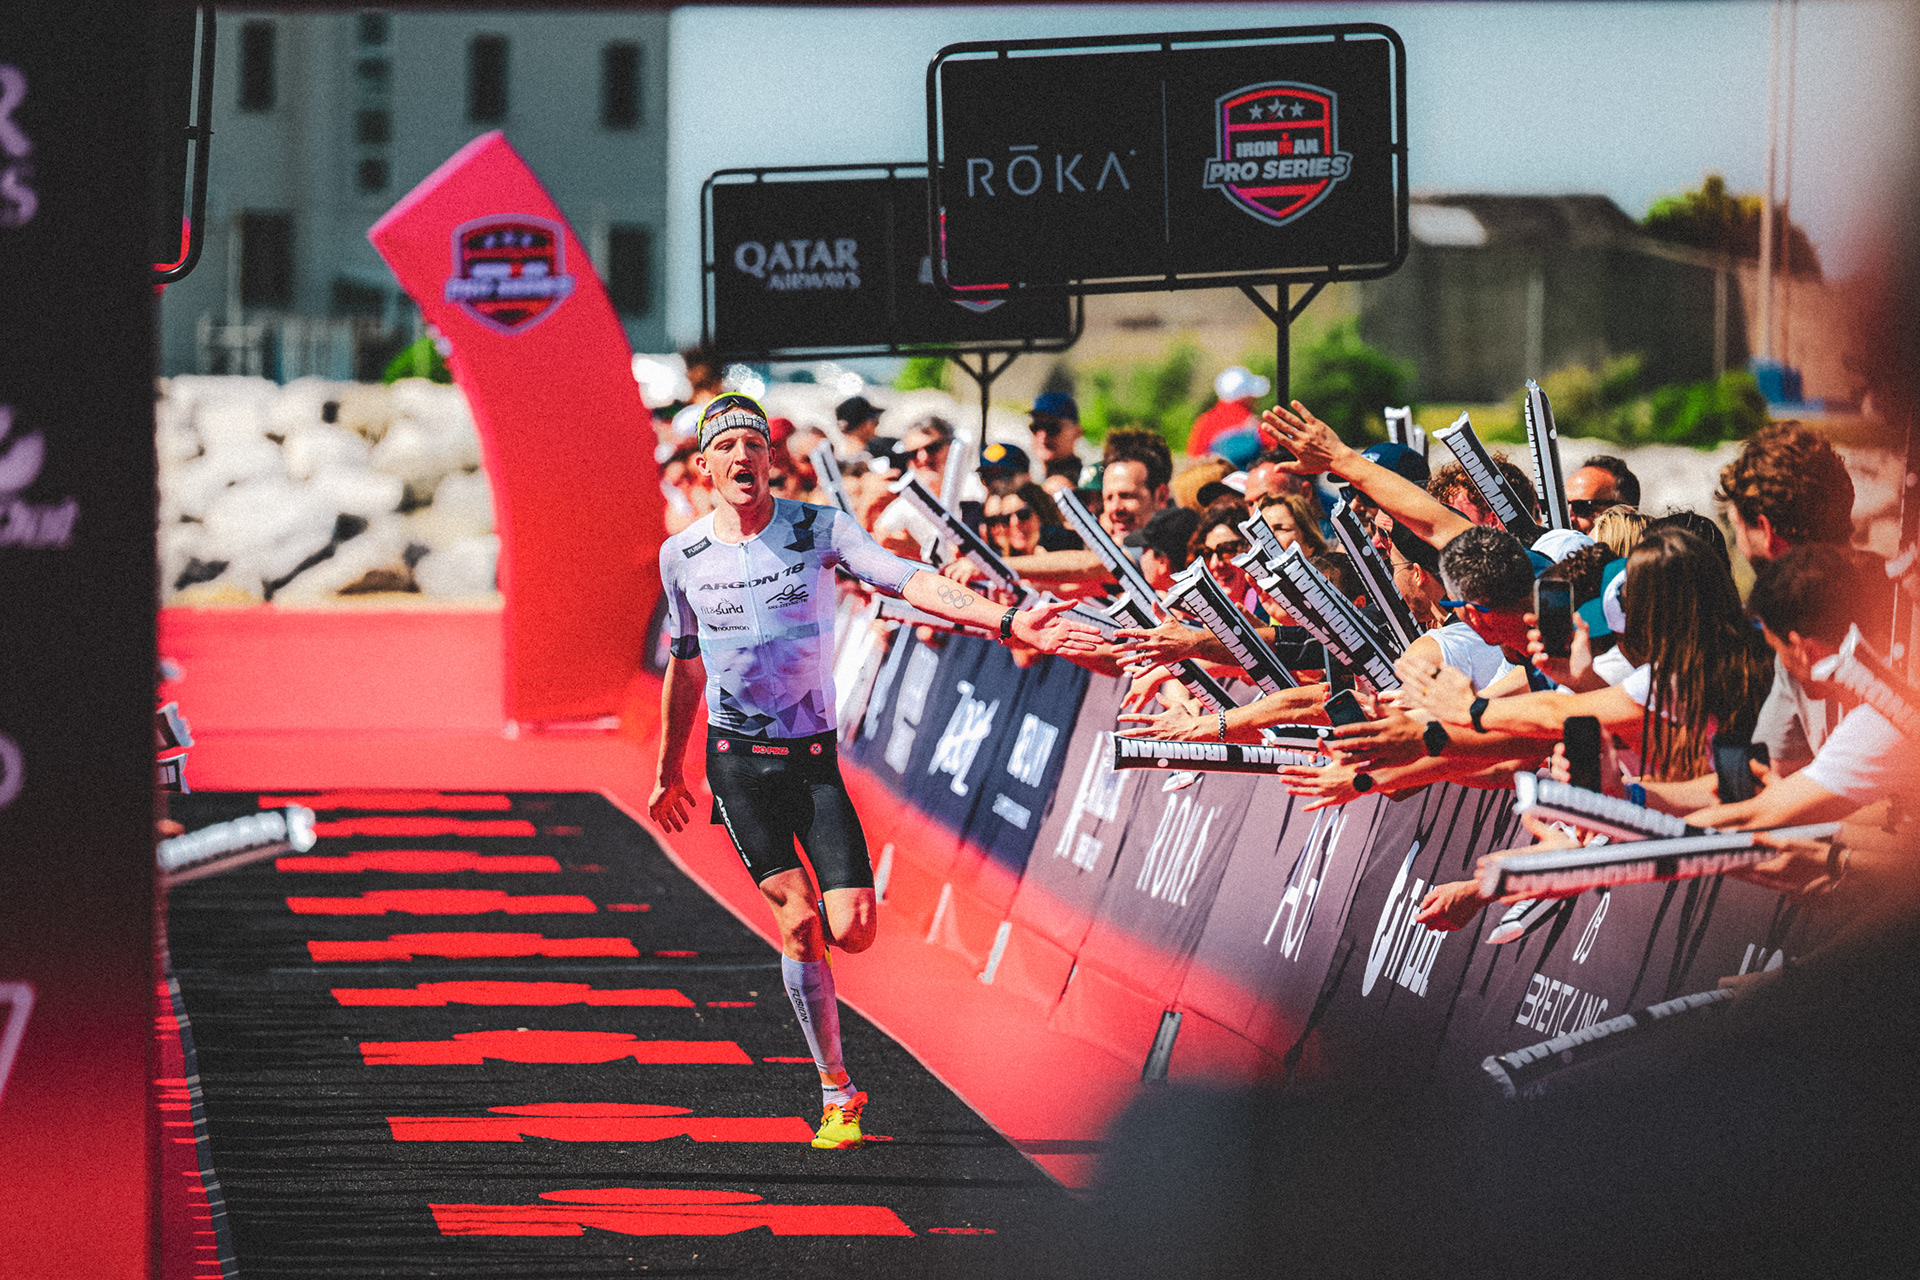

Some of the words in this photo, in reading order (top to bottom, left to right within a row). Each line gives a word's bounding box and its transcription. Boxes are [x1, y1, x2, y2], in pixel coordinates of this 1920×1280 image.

[1235, 135, 1319, 158] IRONMAN
[1209, 158, 1259, 183] PRO
[1262, 154, 1347, 181] SERIES
[734, 238, 859, 278] QATAR
[1446, 430, 1518, 525] IRONMAN
[687, 540, 708, 555] FUSION
[698, 572, 780, 591] ARGON
[782, 562, 806, 577] 18
[1283, 559, 1366, 653] IRONMAN
[1183, 587, 1259, 671] IRONMAN
[1270, 586, 1354, 666] IRONMAN
[1120, 738, 1228, 762] IRONMAN
[789, 986, 809, 1023] FUSION
